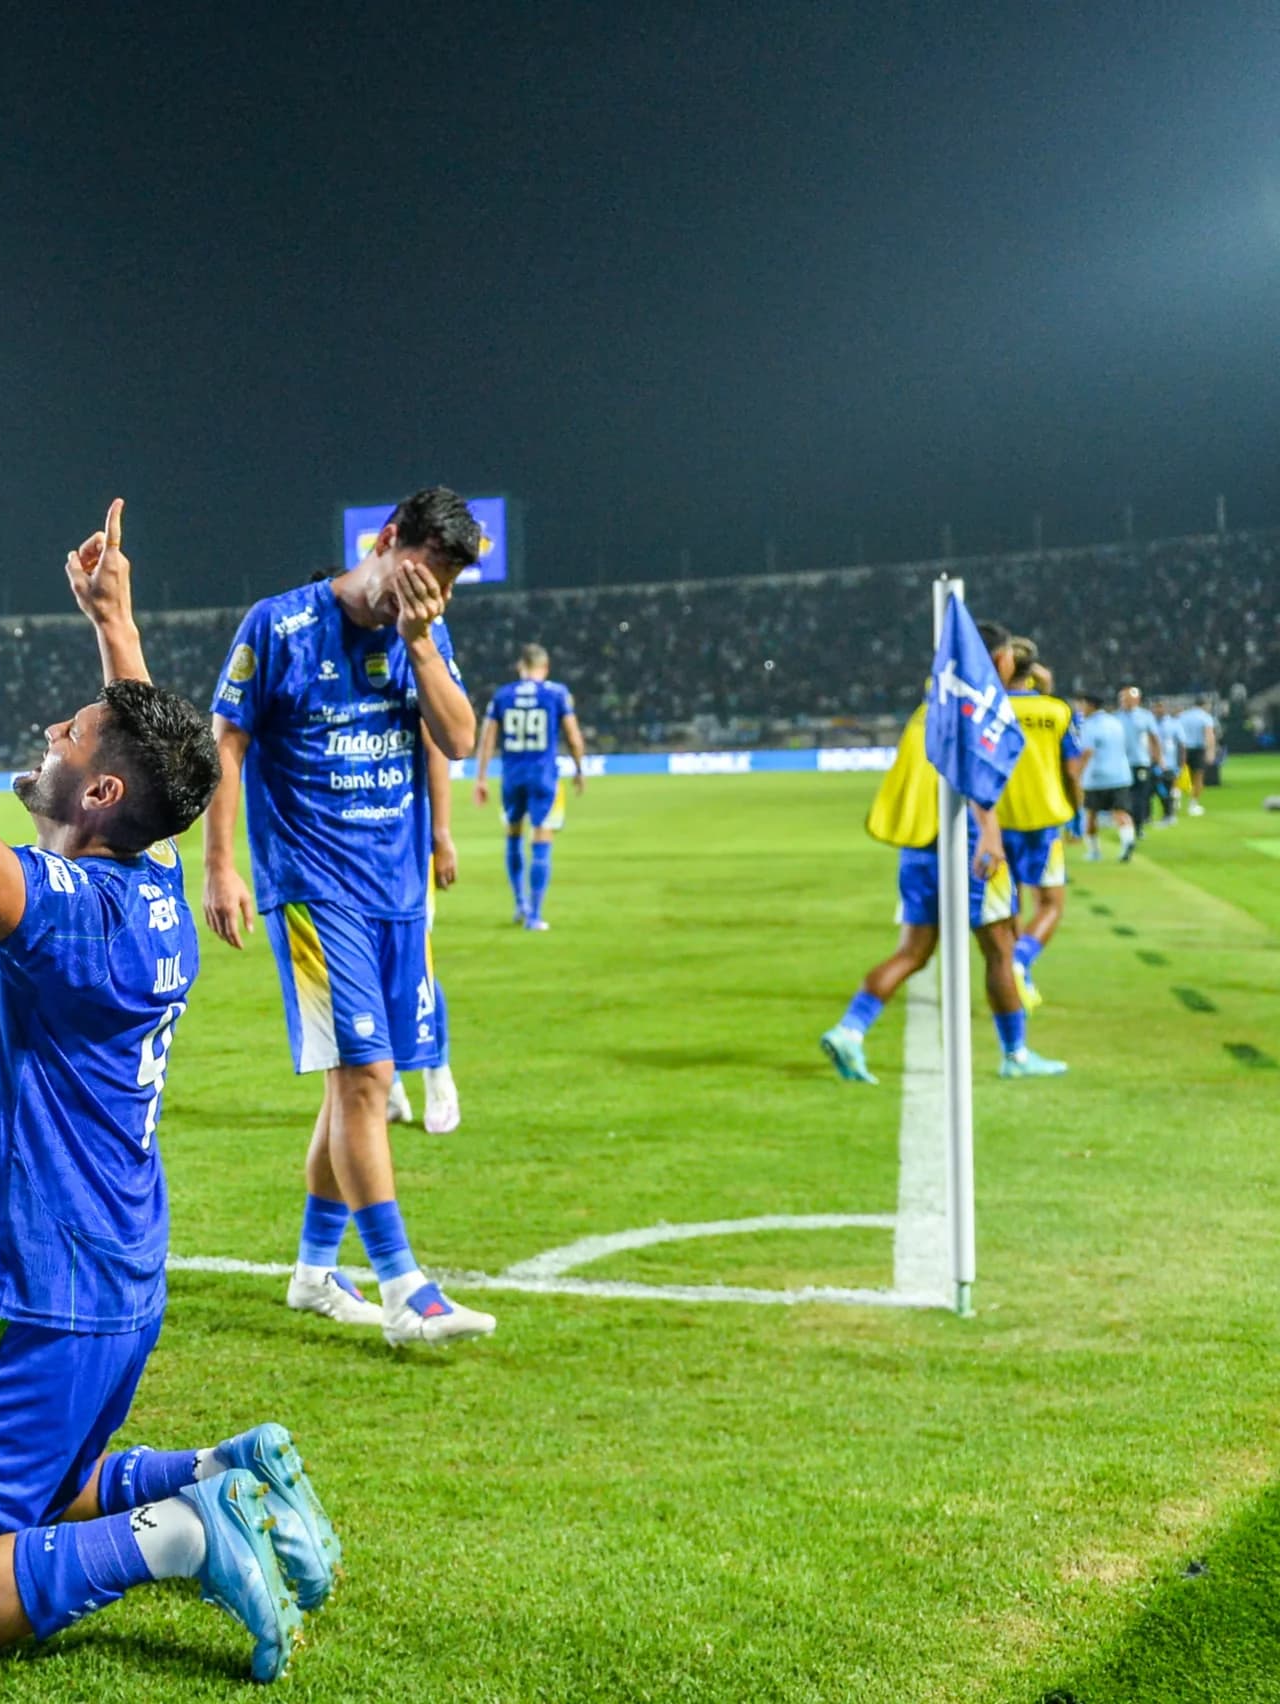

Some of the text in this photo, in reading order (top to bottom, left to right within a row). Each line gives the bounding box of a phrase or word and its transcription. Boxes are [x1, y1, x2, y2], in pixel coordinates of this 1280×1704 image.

[504, 708, 548, 752] 99
[331, 767, 404, 791] bank bjb
[137, 1001, 187, 1150] 4
